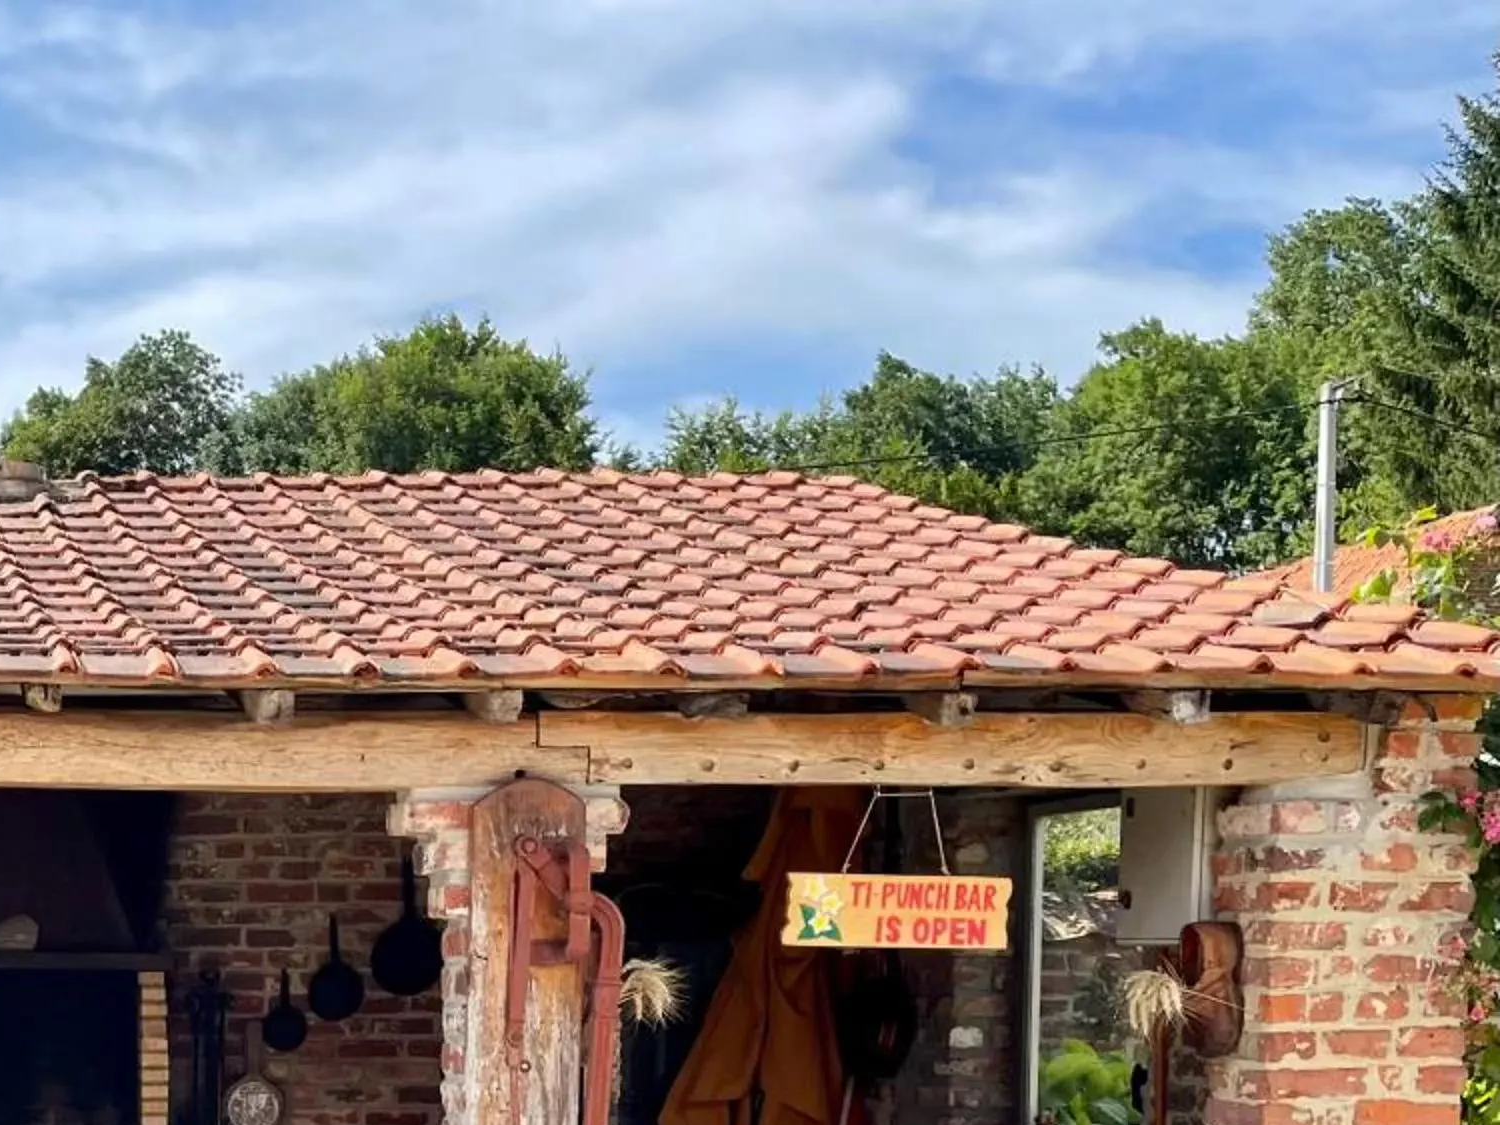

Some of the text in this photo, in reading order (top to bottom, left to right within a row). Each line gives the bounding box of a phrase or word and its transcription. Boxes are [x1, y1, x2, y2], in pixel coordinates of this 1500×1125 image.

[851, 881, 997, 912] TI-PUNCH BAR
[875, 913, 987, 945] IS OPEN
